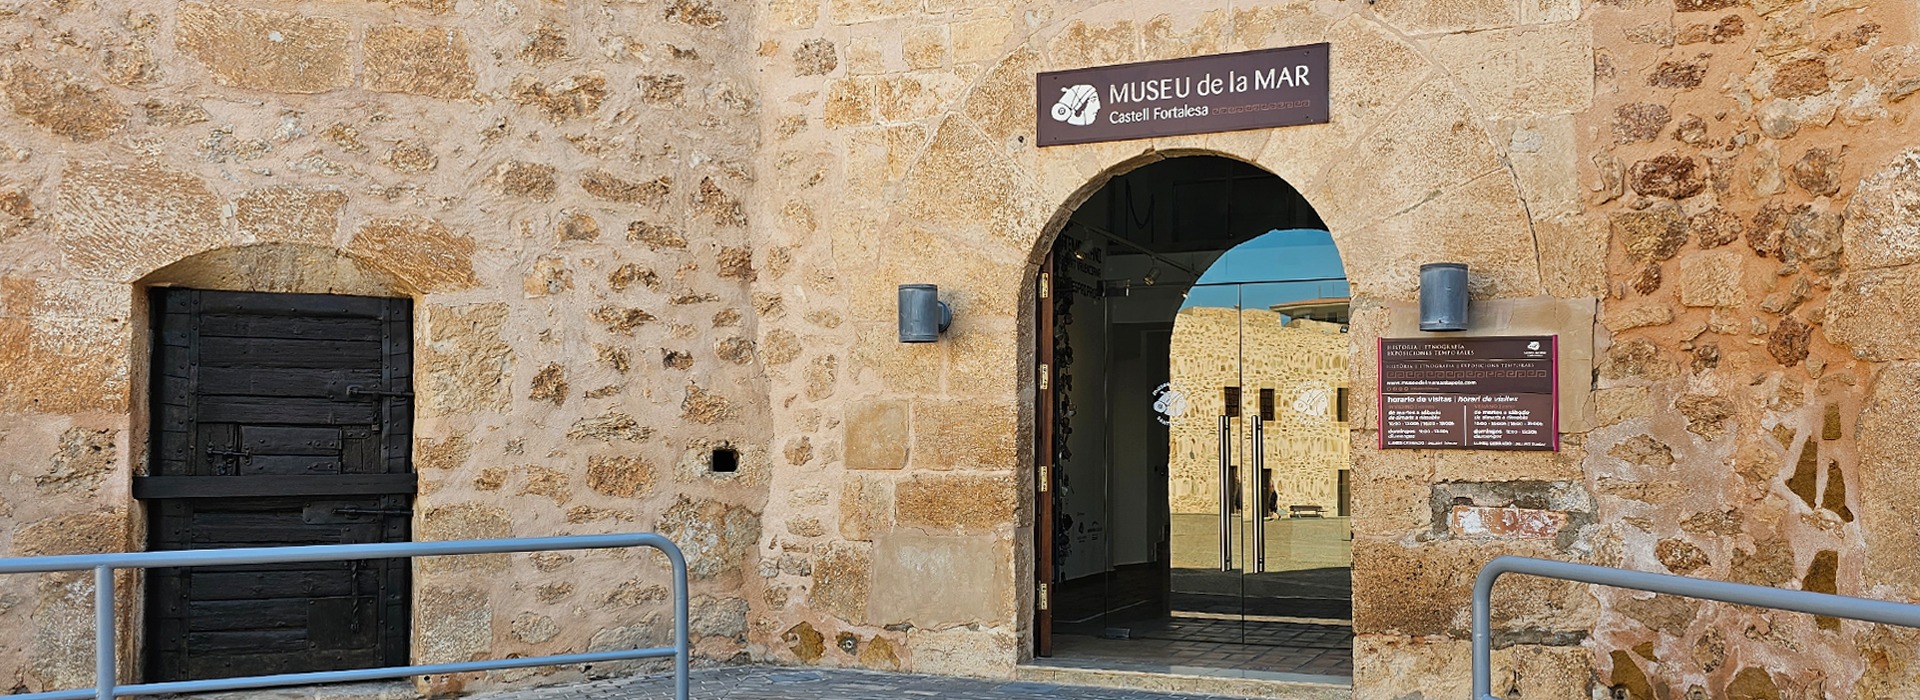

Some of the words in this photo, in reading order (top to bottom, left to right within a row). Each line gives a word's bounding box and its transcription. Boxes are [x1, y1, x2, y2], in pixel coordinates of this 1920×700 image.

[1109, 76, 1191, 105] MUSEU
[1197, 73, 1224, 96] de
[1229, 70, 1247, 93] la
[1254, 65, 1310, 91] MAR
[1109, 108, 1150, 125] Castell
[1153, 104, 1209, 121] Fortalesa
